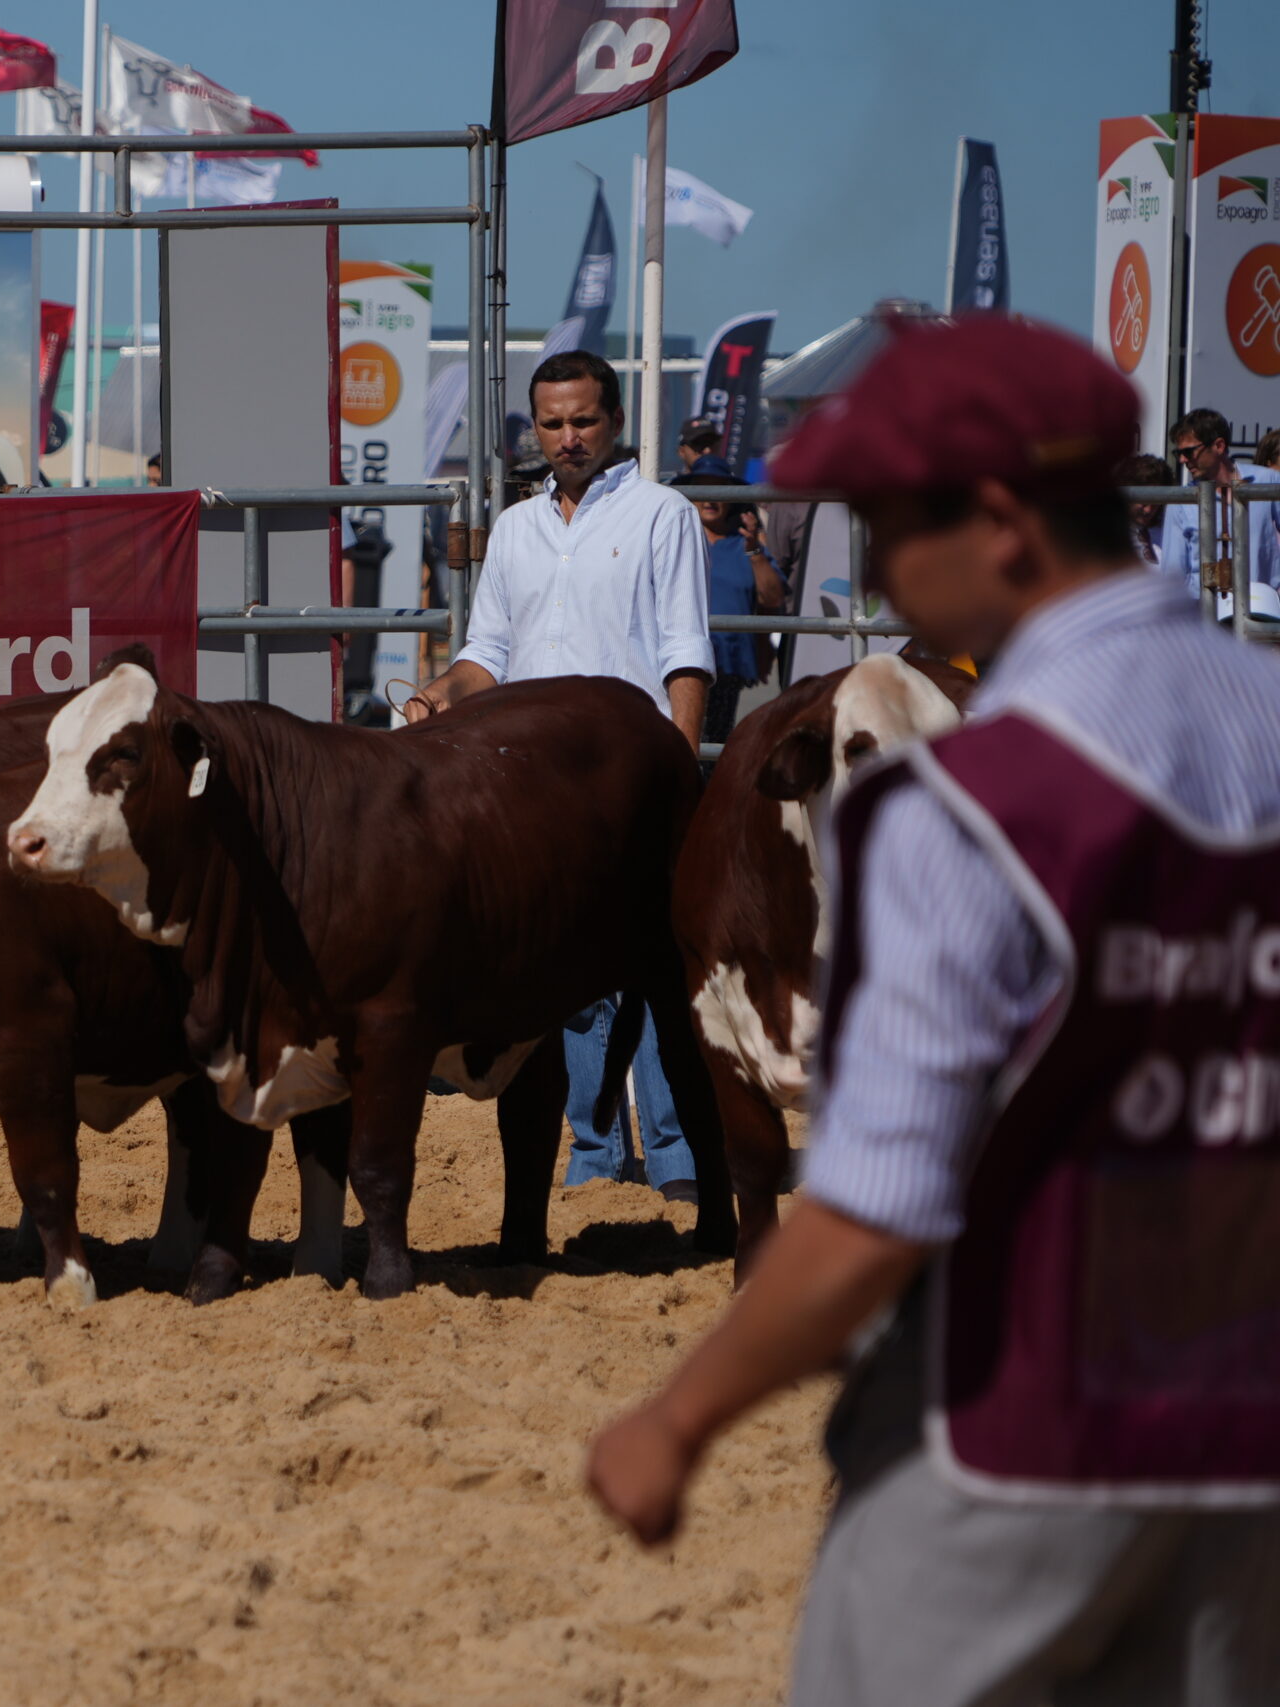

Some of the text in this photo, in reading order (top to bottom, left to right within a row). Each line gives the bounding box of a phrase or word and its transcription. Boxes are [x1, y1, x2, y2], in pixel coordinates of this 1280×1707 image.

[1105, 206, 1132, 225] Expoagro
[1138, 196, 1160, 222] agro
[1216, 204, 1269, 224] Expoagro
